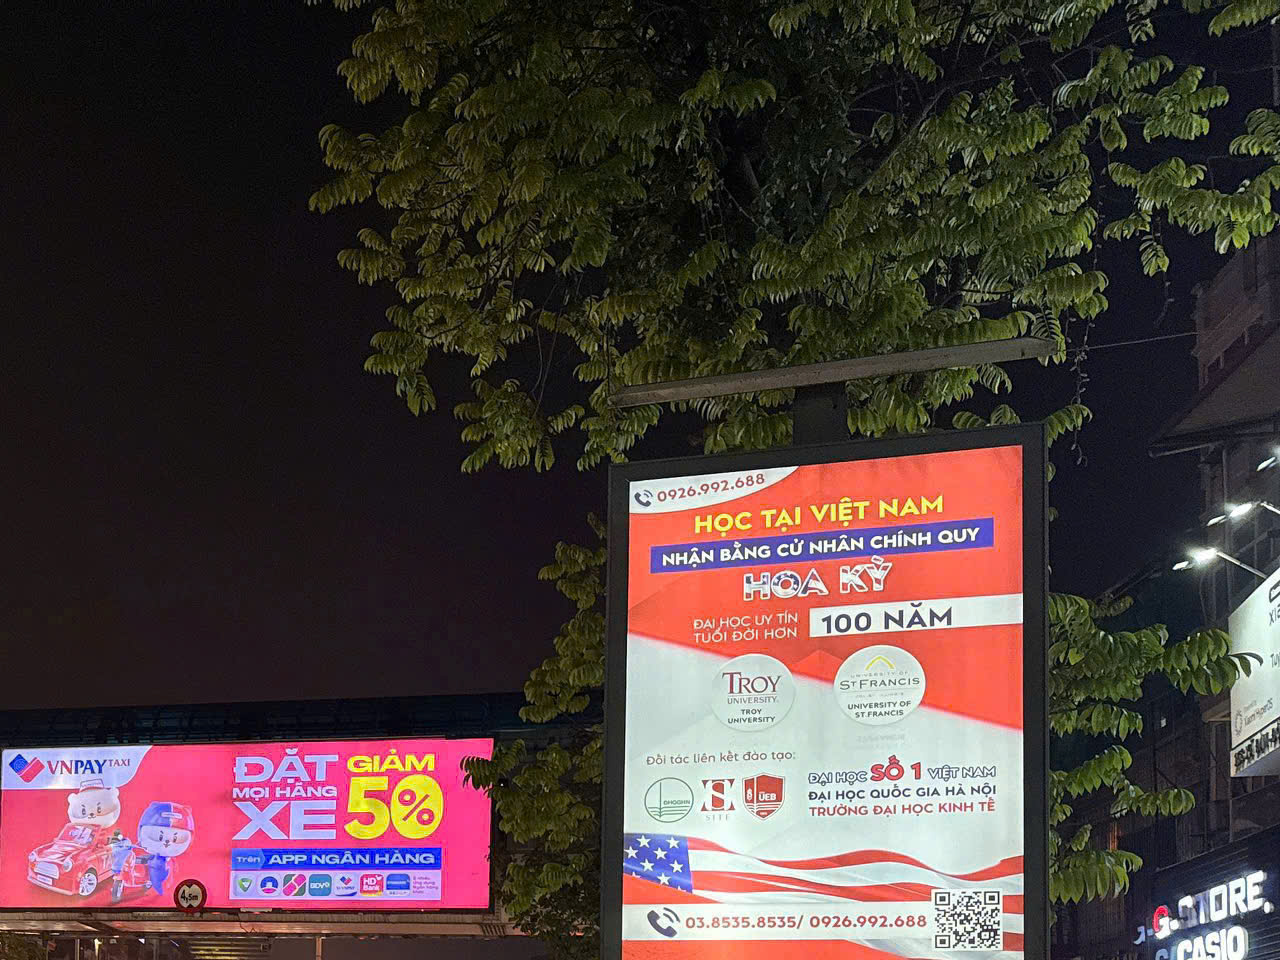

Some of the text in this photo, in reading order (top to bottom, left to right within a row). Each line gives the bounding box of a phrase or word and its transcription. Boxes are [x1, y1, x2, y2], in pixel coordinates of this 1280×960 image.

[657, 473, 765, 503] 0926.992.688
[694, 495, 944, 537] HỌC TẠI VIỆT NAM
[662, 527, 980, 568] NHẬN BẰNG CỬ NHÂN CHÍNH QUY
[743, 555, 893, 601] HOA KỲ
[719, 612, 799, 631] HỌC UY TÍN
[821, 602, 953, 634] 100 NĂM
[693, 626, 798, 644] TUỔI ĐỜI HƠN
[722, 672, 781, 694] TROY
[727, 696, 777, 705] UNIVERSITY
[847, 702, 897, 710] UNIVERSITY
[727, 716, 776, 724] UNIVERSITY
[233, 748, 339, 782] ĐẶT
[347, 750, 435, 773] GIẢM
[670, 750, 796, 764] tác liên kết đào tạo:
[808, 755, 996, 786] ĐẠI HỌC SỐ 1 VIỆT NAM
[232, 782, 338, 801] MỌI HÃNG
[808, 782, 996, 803] ĐẠI HỌC QUỐC GIA HÀ NỘI
[809, 797, 996, 818] TRƯỜNG ĐẠI HỌC KINH TẾ
[232, 801, 337, 840] XE
[235, 850, 435, 865] Trên APP NGÂN HÀNG
[363, 877, 377, 885] HD
[180, 892, 199, 904] 4,5m
[685, 914, 927, 931] 03.8535.8535/ 0926.992.688
